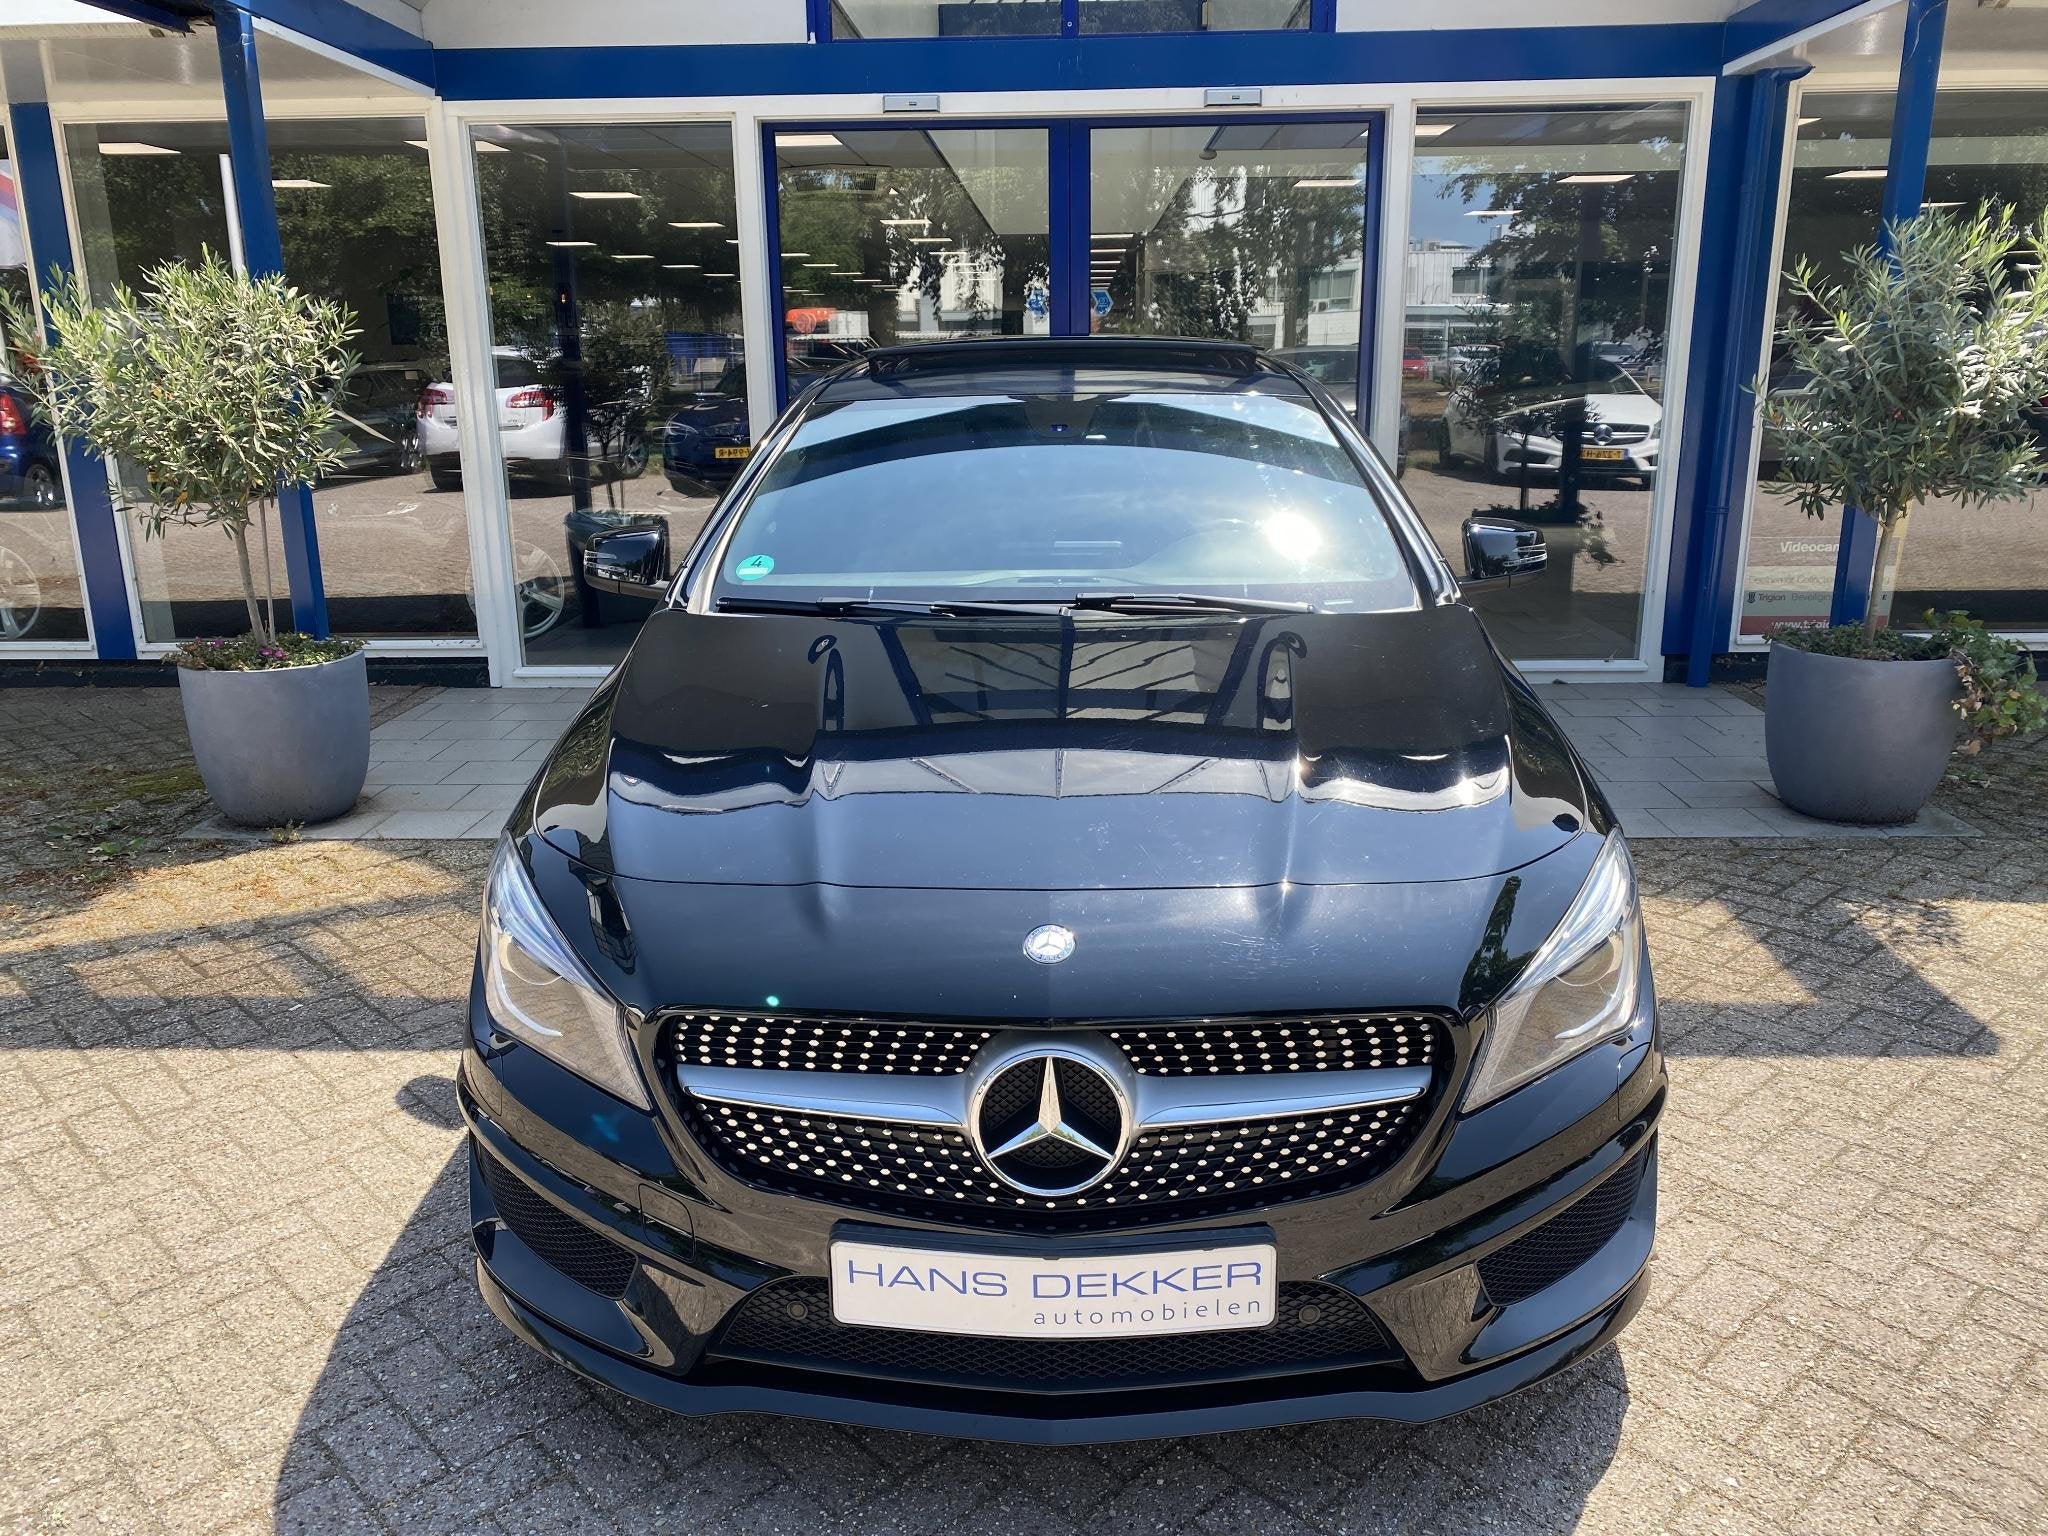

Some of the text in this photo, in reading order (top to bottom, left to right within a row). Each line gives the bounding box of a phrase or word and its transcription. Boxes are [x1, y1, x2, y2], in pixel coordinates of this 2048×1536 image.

[750, 555, 762, 568] 4
[1758, 593, 1786, 603] Trigion
[848, 1260, 1262, 1299] HANS DEKKER
[1033, 1298, 1260, 1325] automobielen
